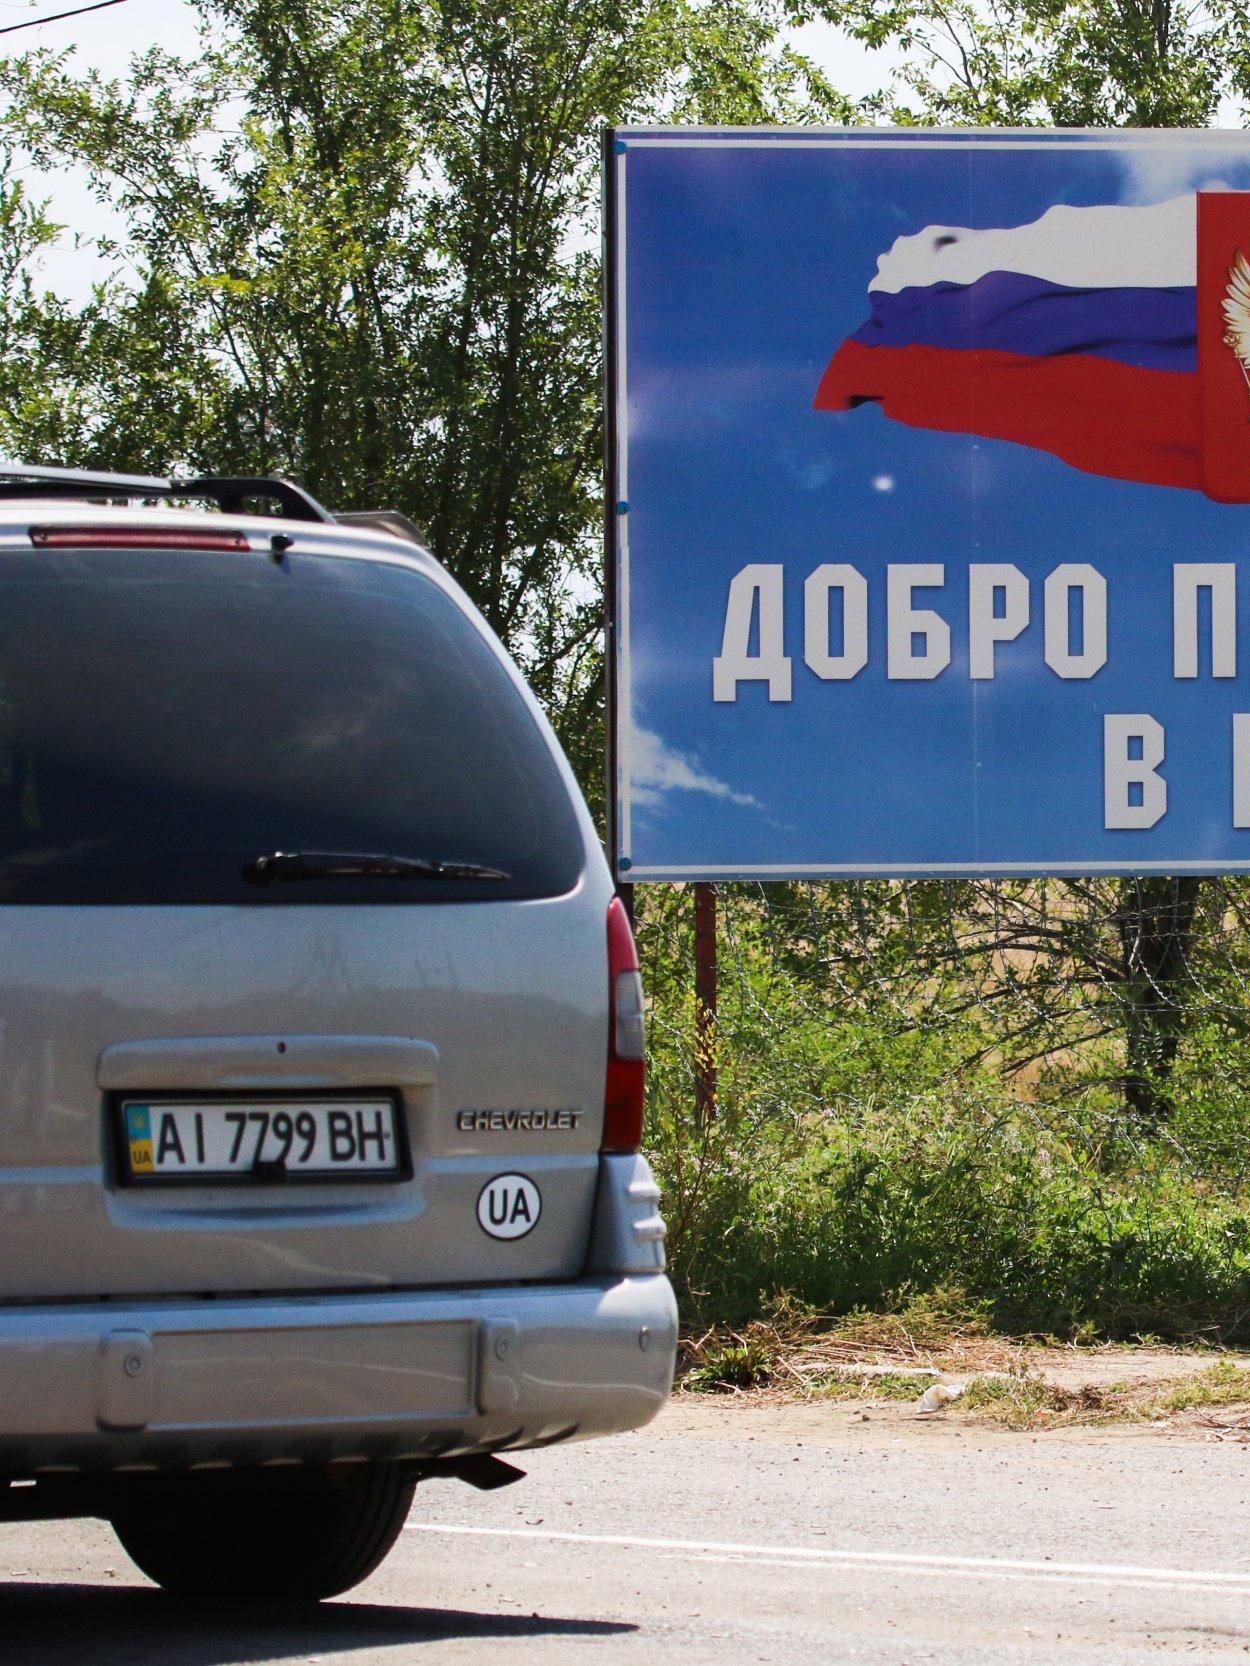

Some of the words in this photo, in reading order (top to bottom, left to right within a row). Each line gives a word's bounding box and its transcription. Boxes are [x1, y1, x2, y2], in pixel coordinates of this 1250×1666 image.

[713, 563, 1108, 702] ДОБРО
[1104, 712, 1168, 830] В
[224, 1111, 317, 1164] 7799
[457, 1109, 584, 1131] CHEVROLET
[488, 1187, 532, 1226] UA
